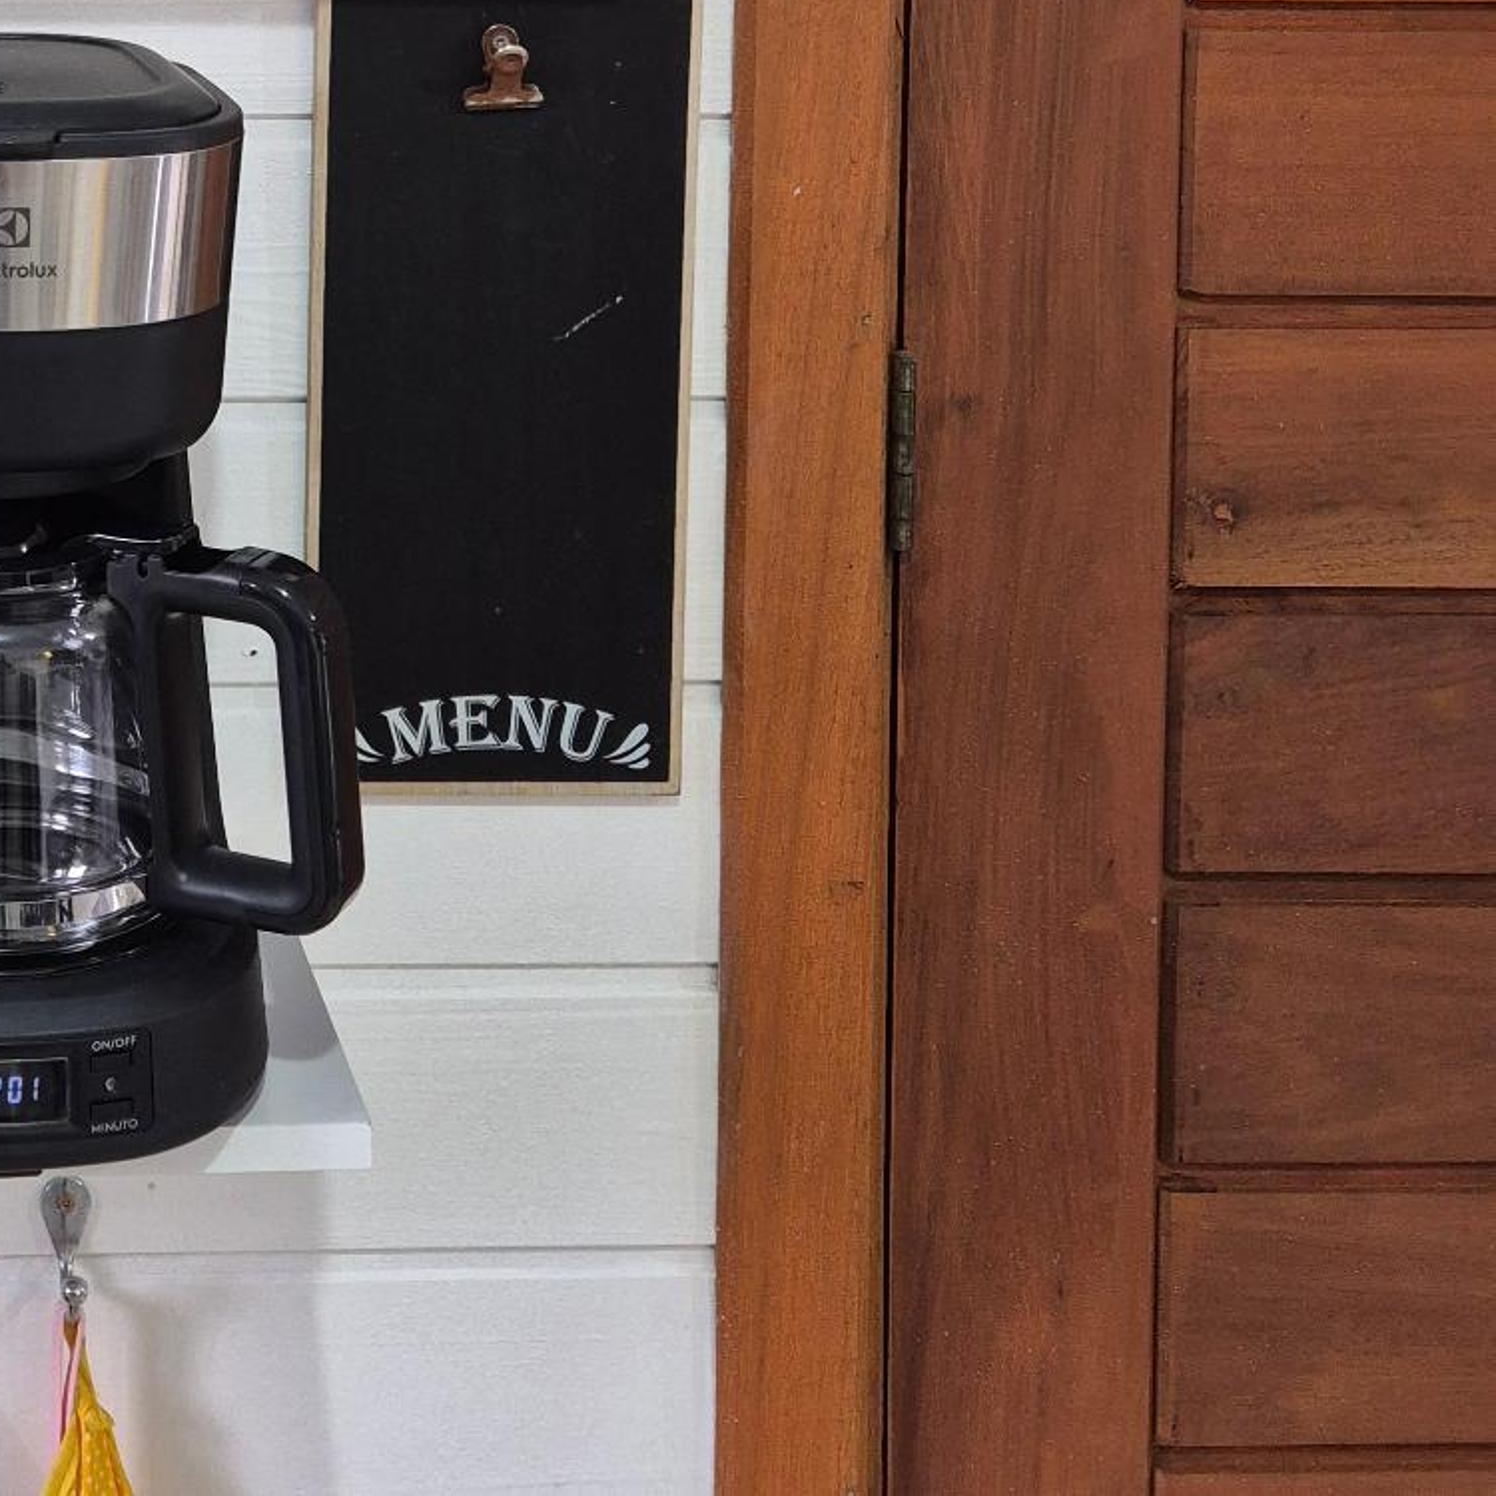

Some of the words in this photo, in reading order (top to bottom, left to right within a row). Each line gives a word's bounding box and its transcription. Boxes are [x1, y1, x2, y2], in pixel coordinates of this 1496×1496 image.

[380, 694, 615, 764] MENU
[91, 1035, 137, 1052] ON/OFF
[91, 1118, 139, 1135] MINUTO
